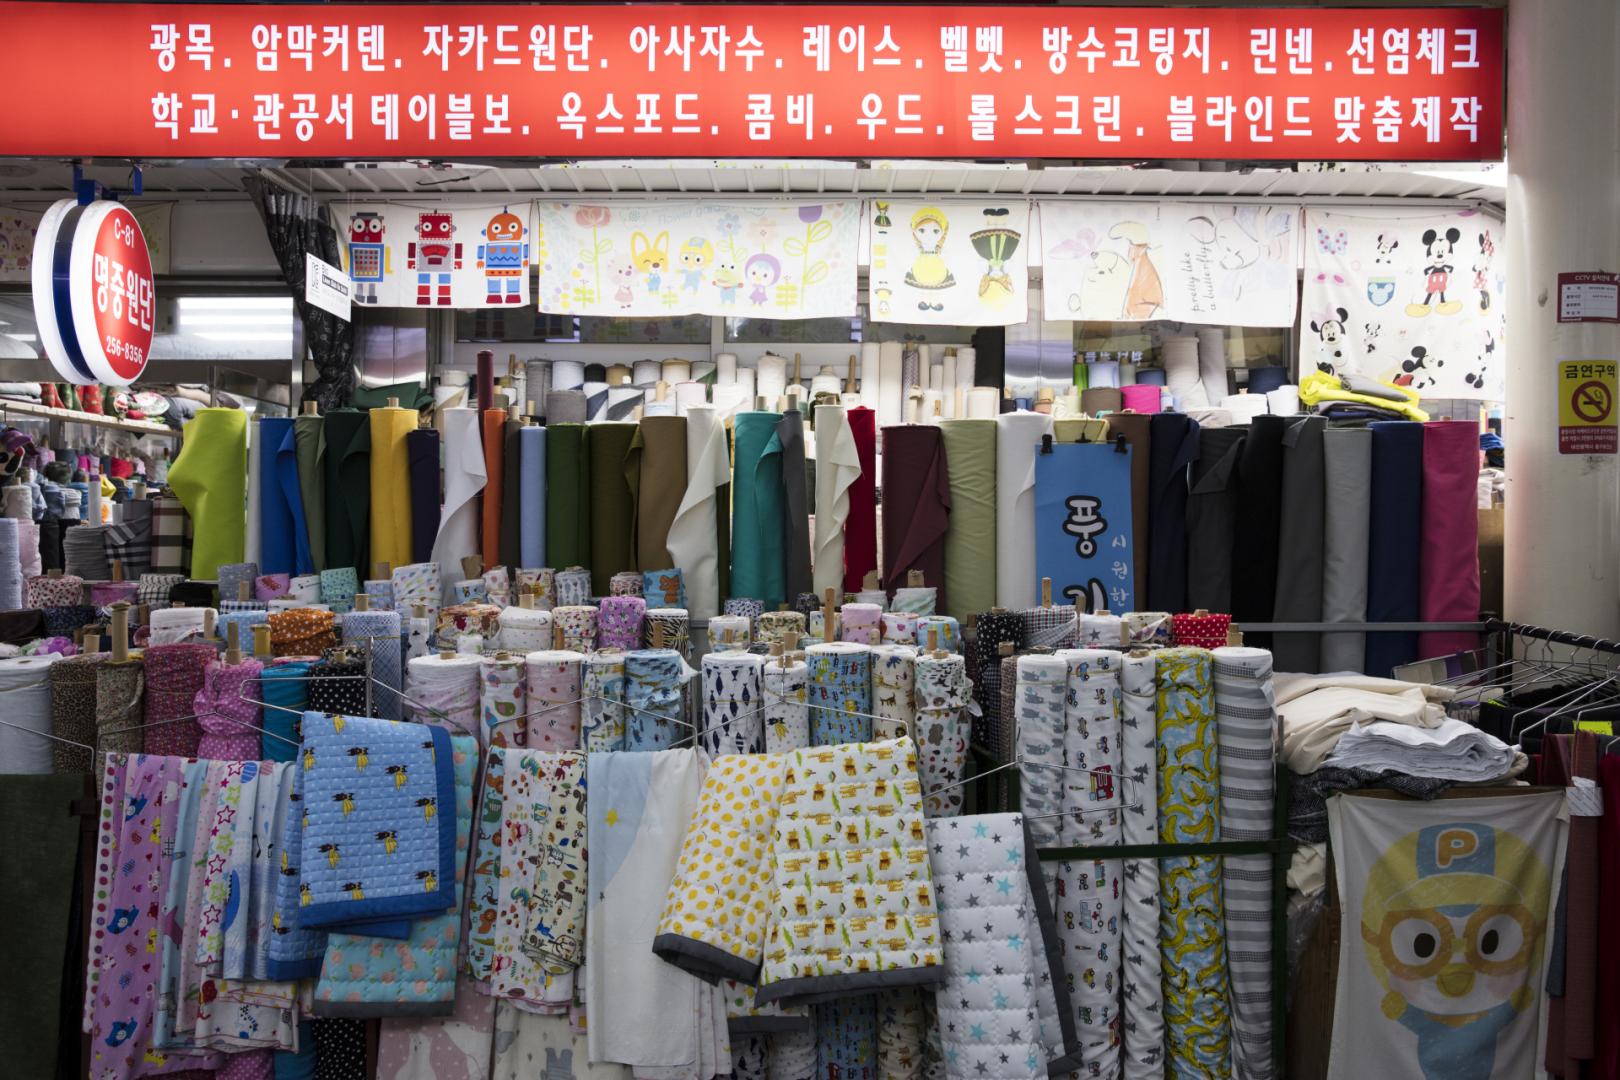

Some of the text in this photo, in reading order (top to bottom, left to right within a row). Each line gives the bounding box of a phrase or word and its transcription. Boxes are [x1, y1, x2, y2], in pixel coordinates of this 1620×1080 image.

[150, 24, 1479, 75] 광목. 암막커텐. 자카드원단. 아사자수. 레이스. 벨벳. 방수코팅지. 린넨. 선염체크
[371, 94, 529, 140] 테이블보.
[557, 92, 718, 139] 옥스포드.
[745, 93, 832, 140] 콤비.
[857, 93, 943, 140] 우드.
[1167, 96, 1312, 142] 블라인드
[1335, 96, 1481, 143] 맞춤제작
[114, 217, 135, 249] C-81
[94, 252, 152, 332] 명중원단
[106, 335, 143, 365] 256-8356
[1564, 364, 1615, 379] 금연구역
[1110, 534, 1129, 607] 시원한
[1436, 828, 1479, 869] P
